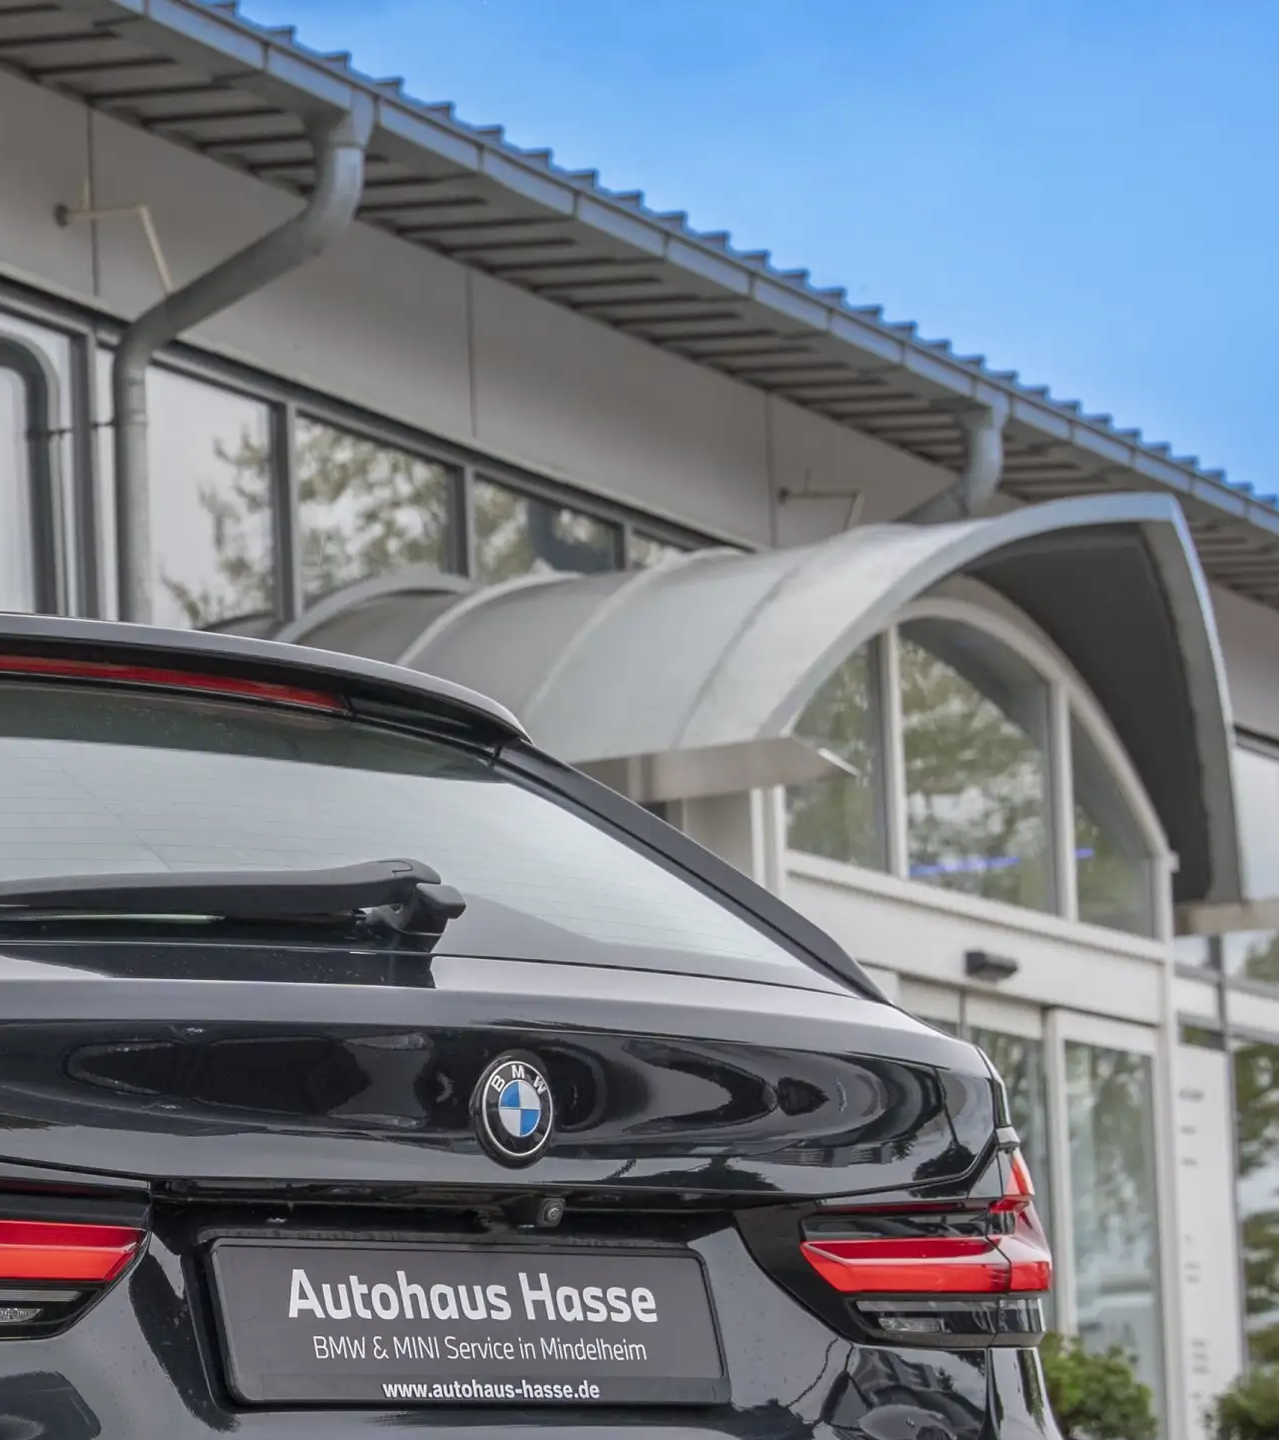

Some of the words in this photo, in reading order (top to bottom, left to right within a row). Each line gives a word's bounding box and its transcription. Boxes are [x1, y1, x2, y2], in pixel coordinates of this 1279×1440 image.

[491, 1065, 547, 1095] BMW
[288, 1269, 512, 1320] Autohaus
[518, 1272, 658, 1323] Hasse
[313, 1335, 367, 1360] BMW
[372, 1337, 388, 1360] &
[393, 1336, 440, 1360] MINI
[444, 1337, 514, 1361] Service
[519, 1338, 536, 1361] in
[540, 1338, 647, 1362] Mindelheim
[382, 1380, 600, 1400] www.autohaus-hasse.de
